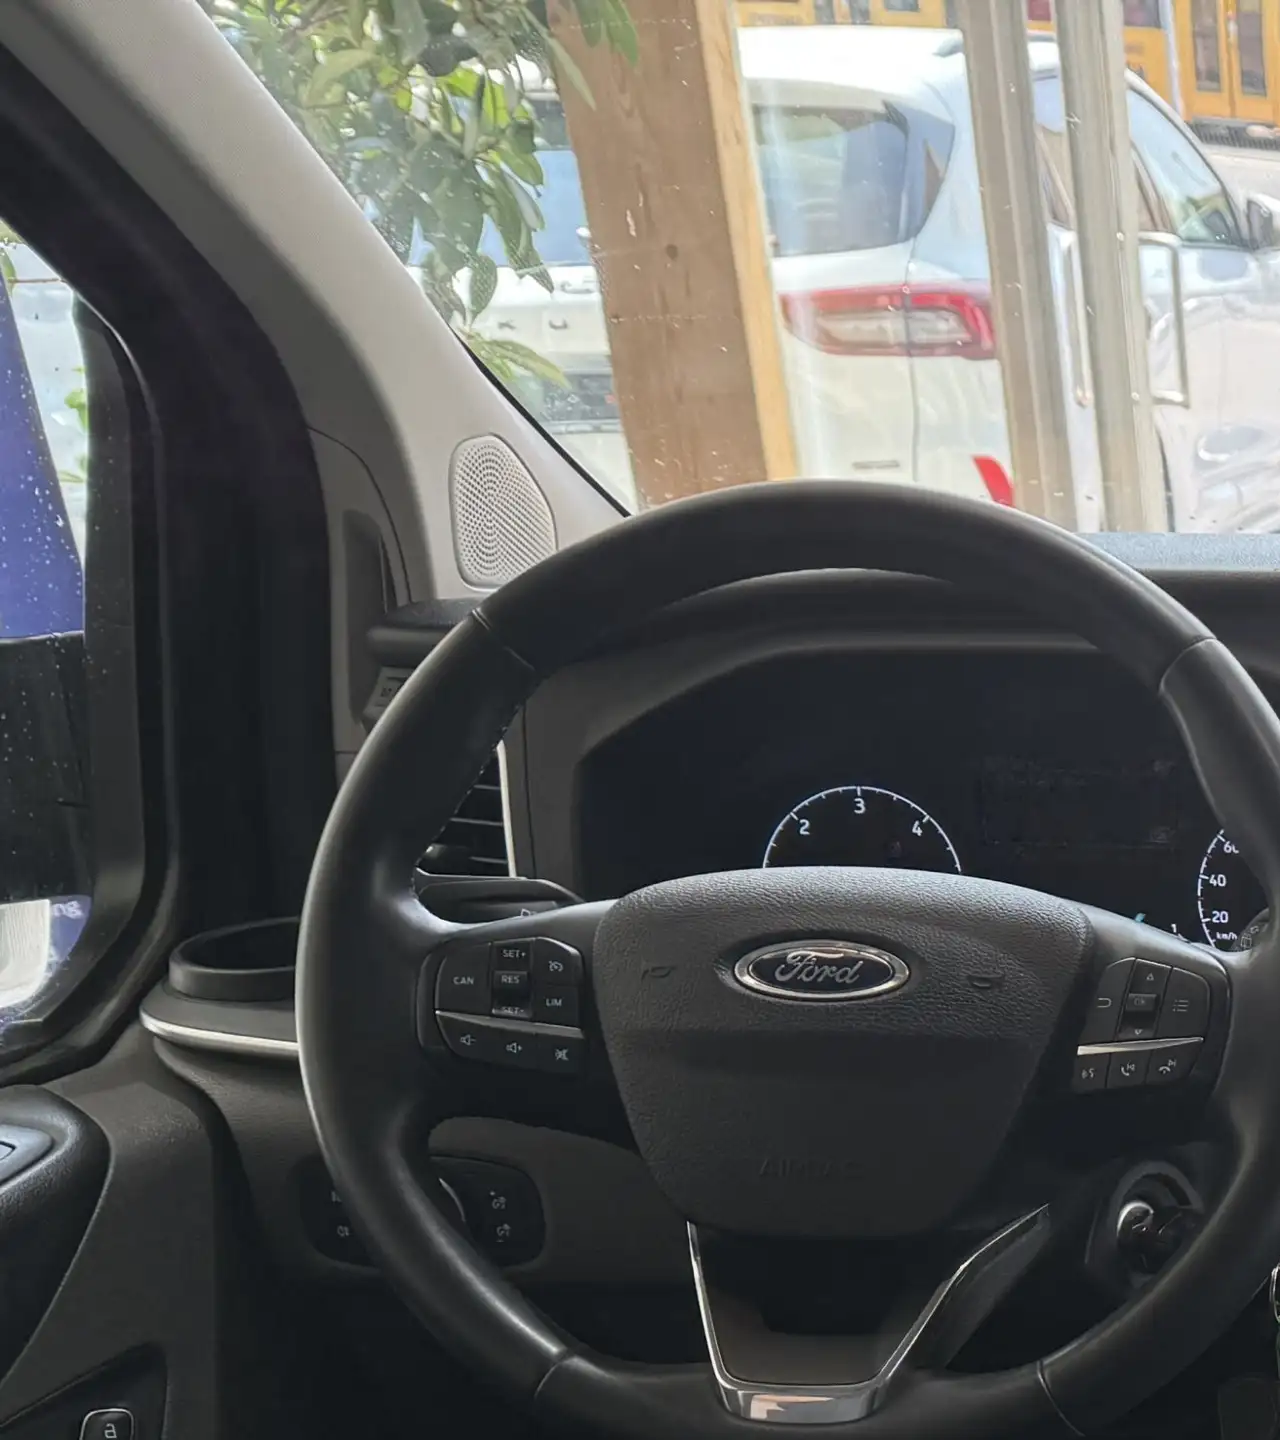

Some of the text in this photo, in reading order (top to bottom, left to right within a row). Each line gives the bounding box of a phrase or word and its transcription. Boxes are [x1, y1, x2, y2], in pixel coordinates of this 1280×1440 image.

[854, 797, 866, 815] 3
[798, 819, 811, 836] 2
[911, 819, 923, 837] 4
[1208, 873, 1227, 887] 40
[1211, 911, 1229, 924] 20
[1216, 931, 1237, 941] km/h
[774, 949, 864, 985] Ford
[453, 976, 474, 986] CAN
[501, 974, 520, 984] RES
[545, 997, 562, 1007] LIM
